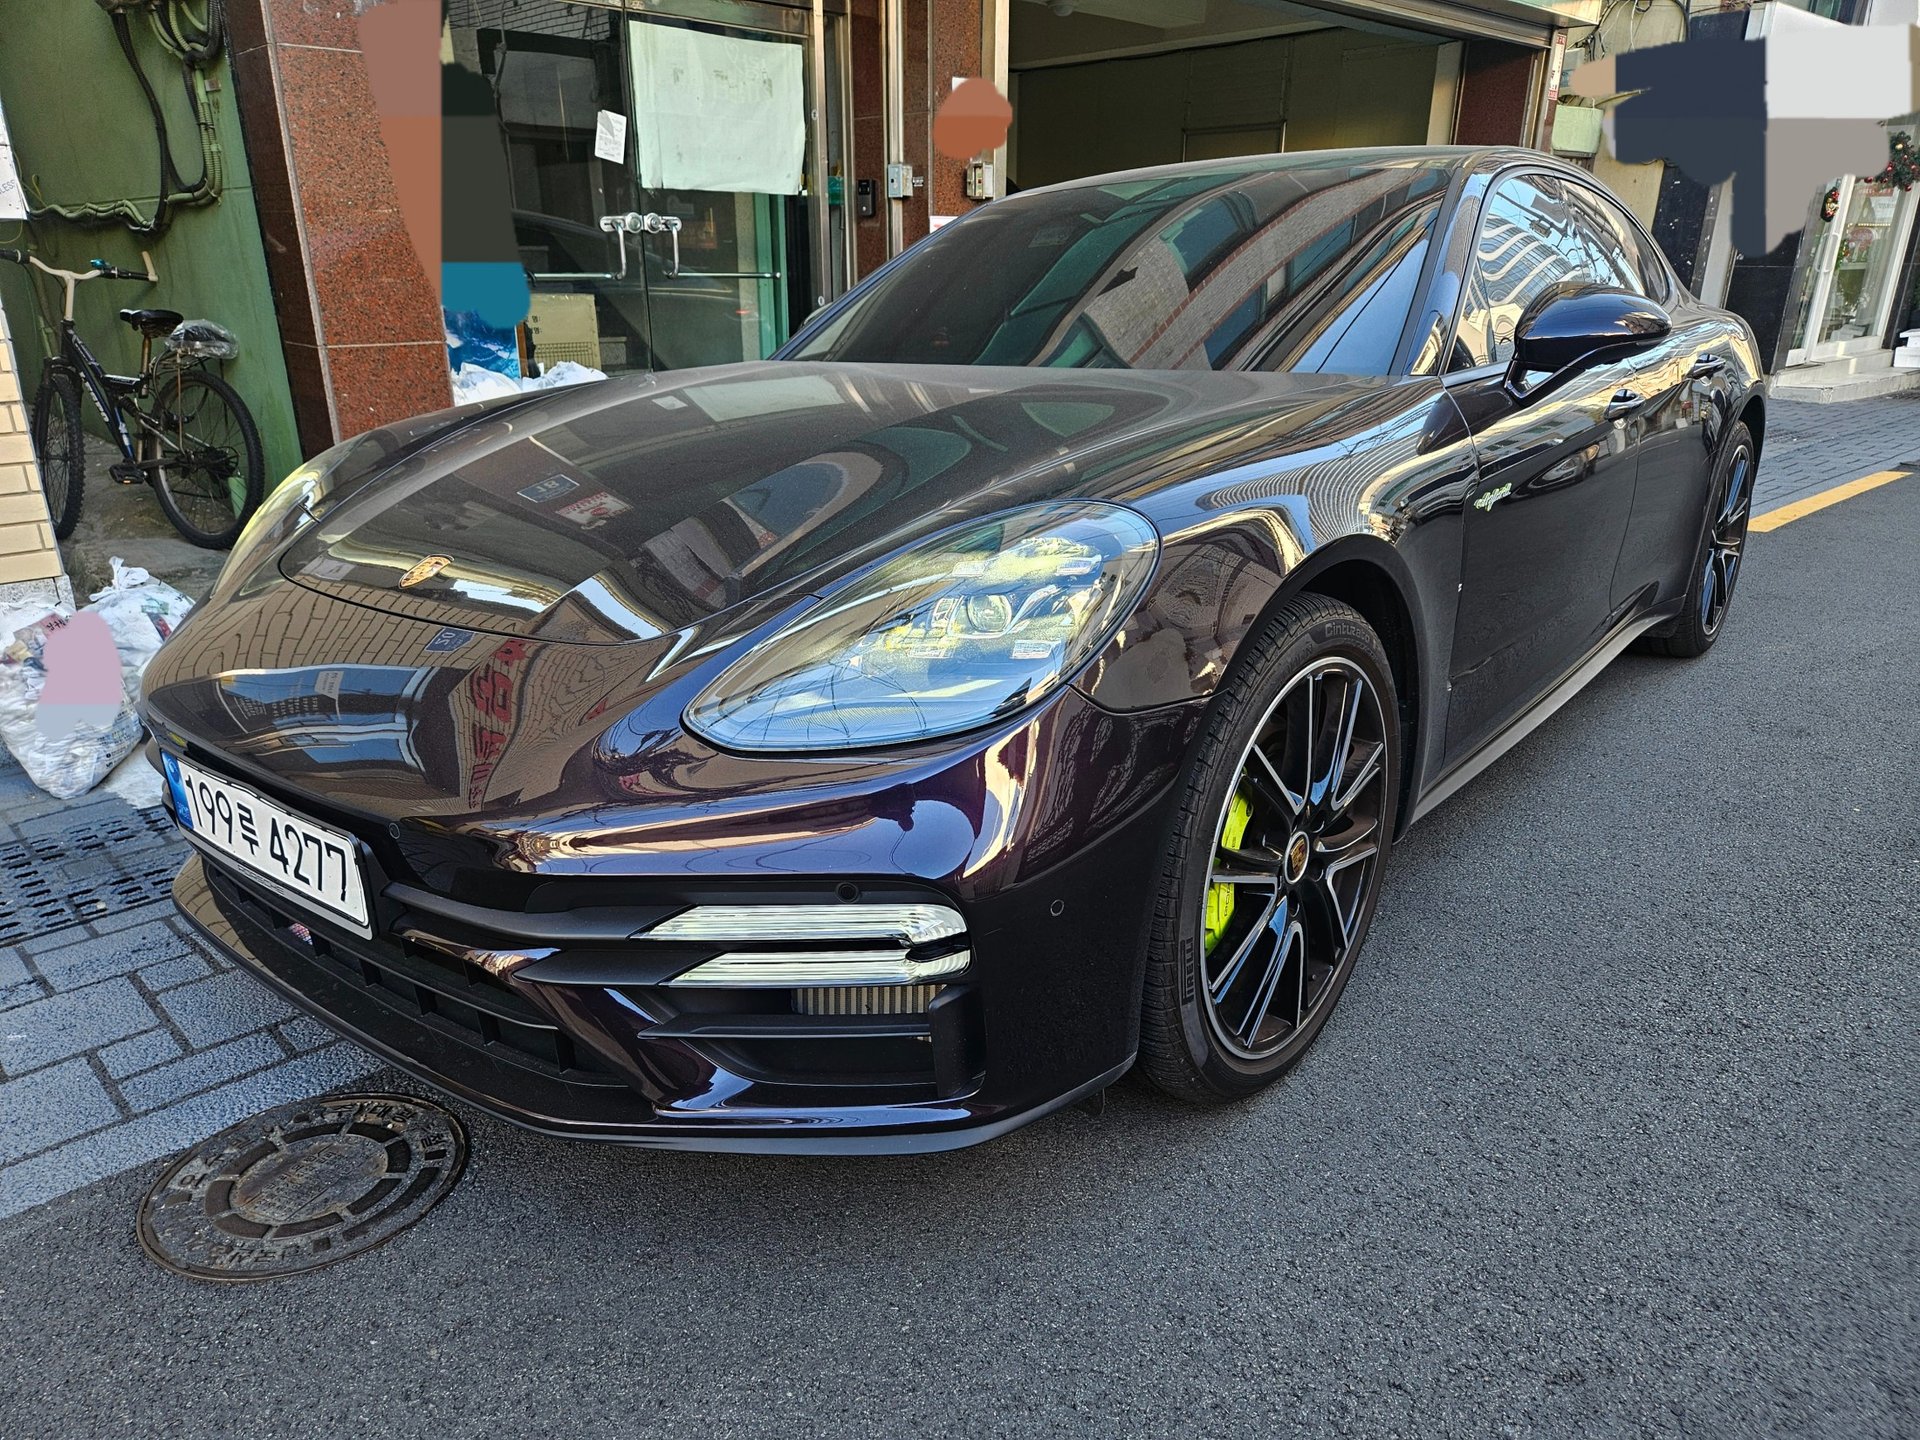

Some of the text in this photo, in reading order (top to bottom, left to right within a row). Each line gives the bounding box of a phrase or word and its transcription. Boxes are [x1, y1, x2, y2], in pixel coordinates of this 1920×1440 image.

[1324, 622, 1371, 643] Cinturato
[184, 774, 348, 902] 199루 4277
[1179, 937, 1195, 1006] PIRELLI
